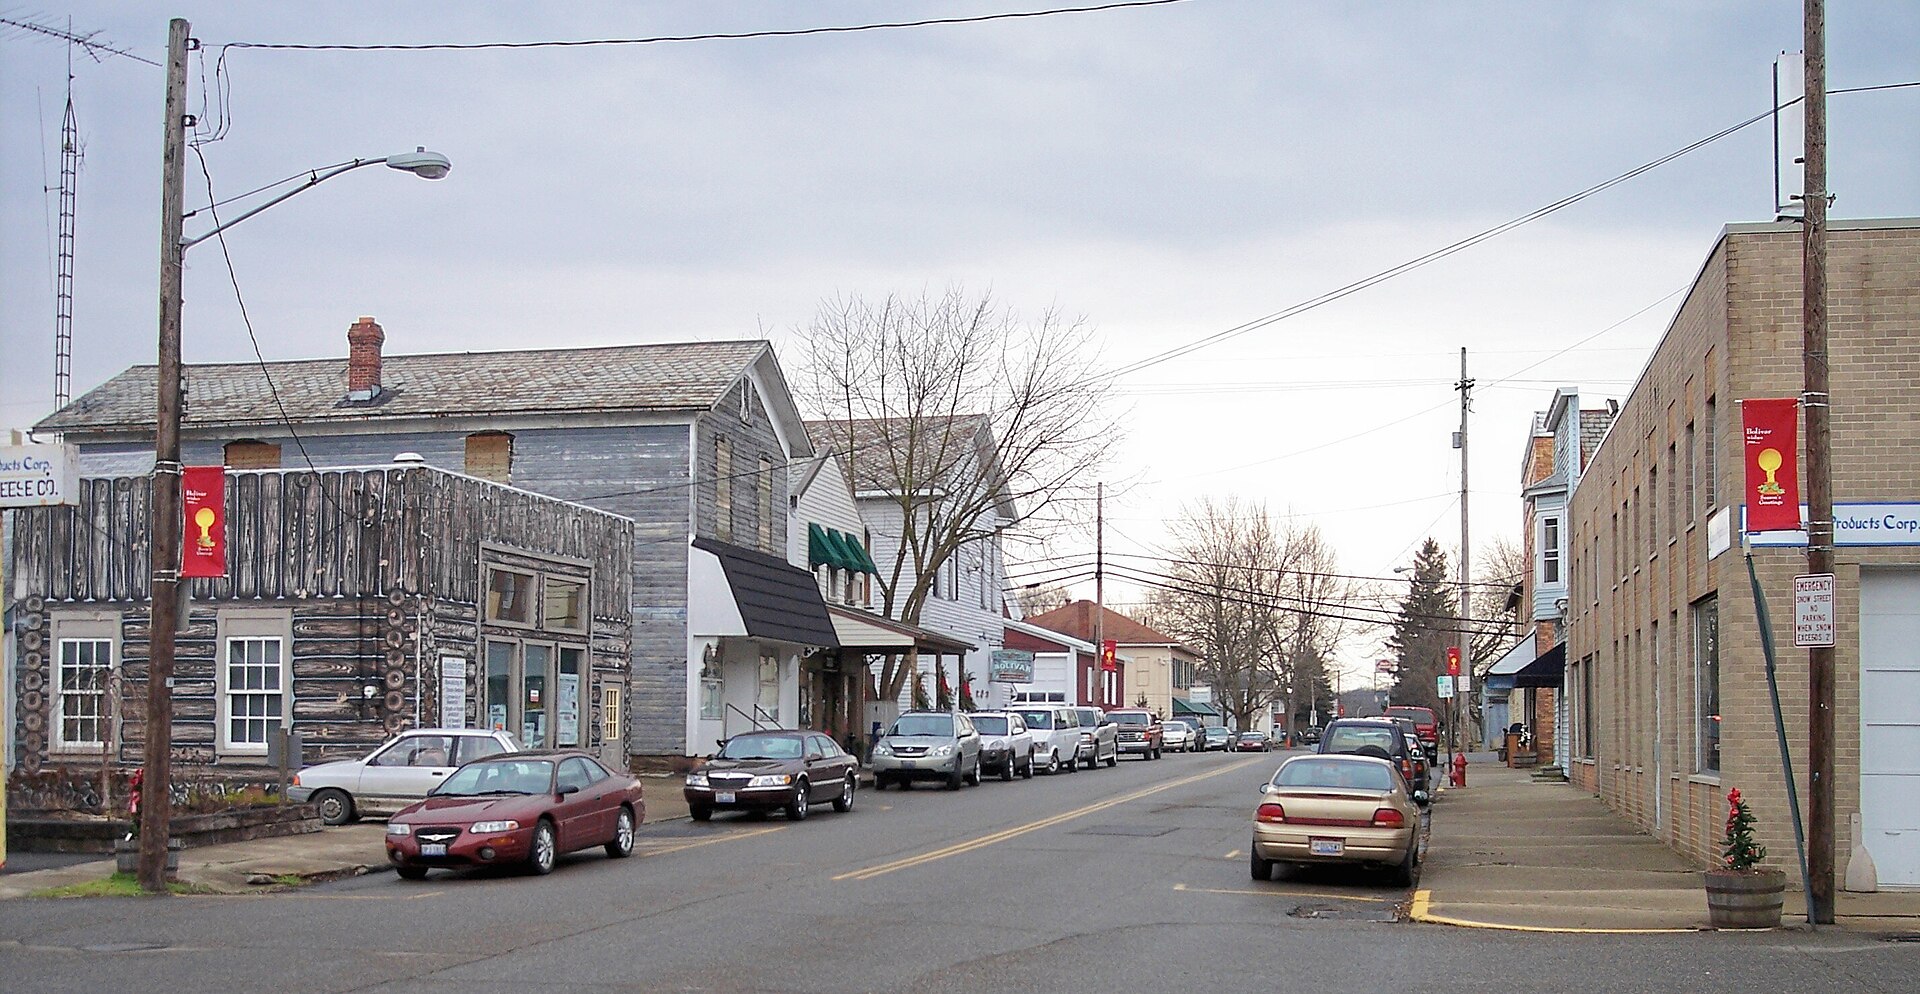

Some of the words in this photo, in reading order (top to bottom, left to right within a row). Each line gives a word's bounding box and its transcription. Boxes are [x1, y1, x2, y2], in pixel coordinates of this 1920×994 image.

[1746, 427, 1772, 435] Bolivar
[23, 456, 53, 473] Corp.
[37, 479, 59, 496] CO.
[1883, 514, 1920, 533] Corp.
[1797, 580, 1831, 592] EMERGENCY
[1797, 595, 1811, 604] SNOW
[1813, 594, 1831, 602] STREET
[1809, 604, 1818, 612] NO
[1802, 614, 1826, 623] PARKING
[1797, 624, 1812, 632] WHEN
[1816, 623, 1832, 632] SNOW
[1797, 633, 1823, 642] EXCEEDS
[994, 662, 1031, 673] BOLIVAR
